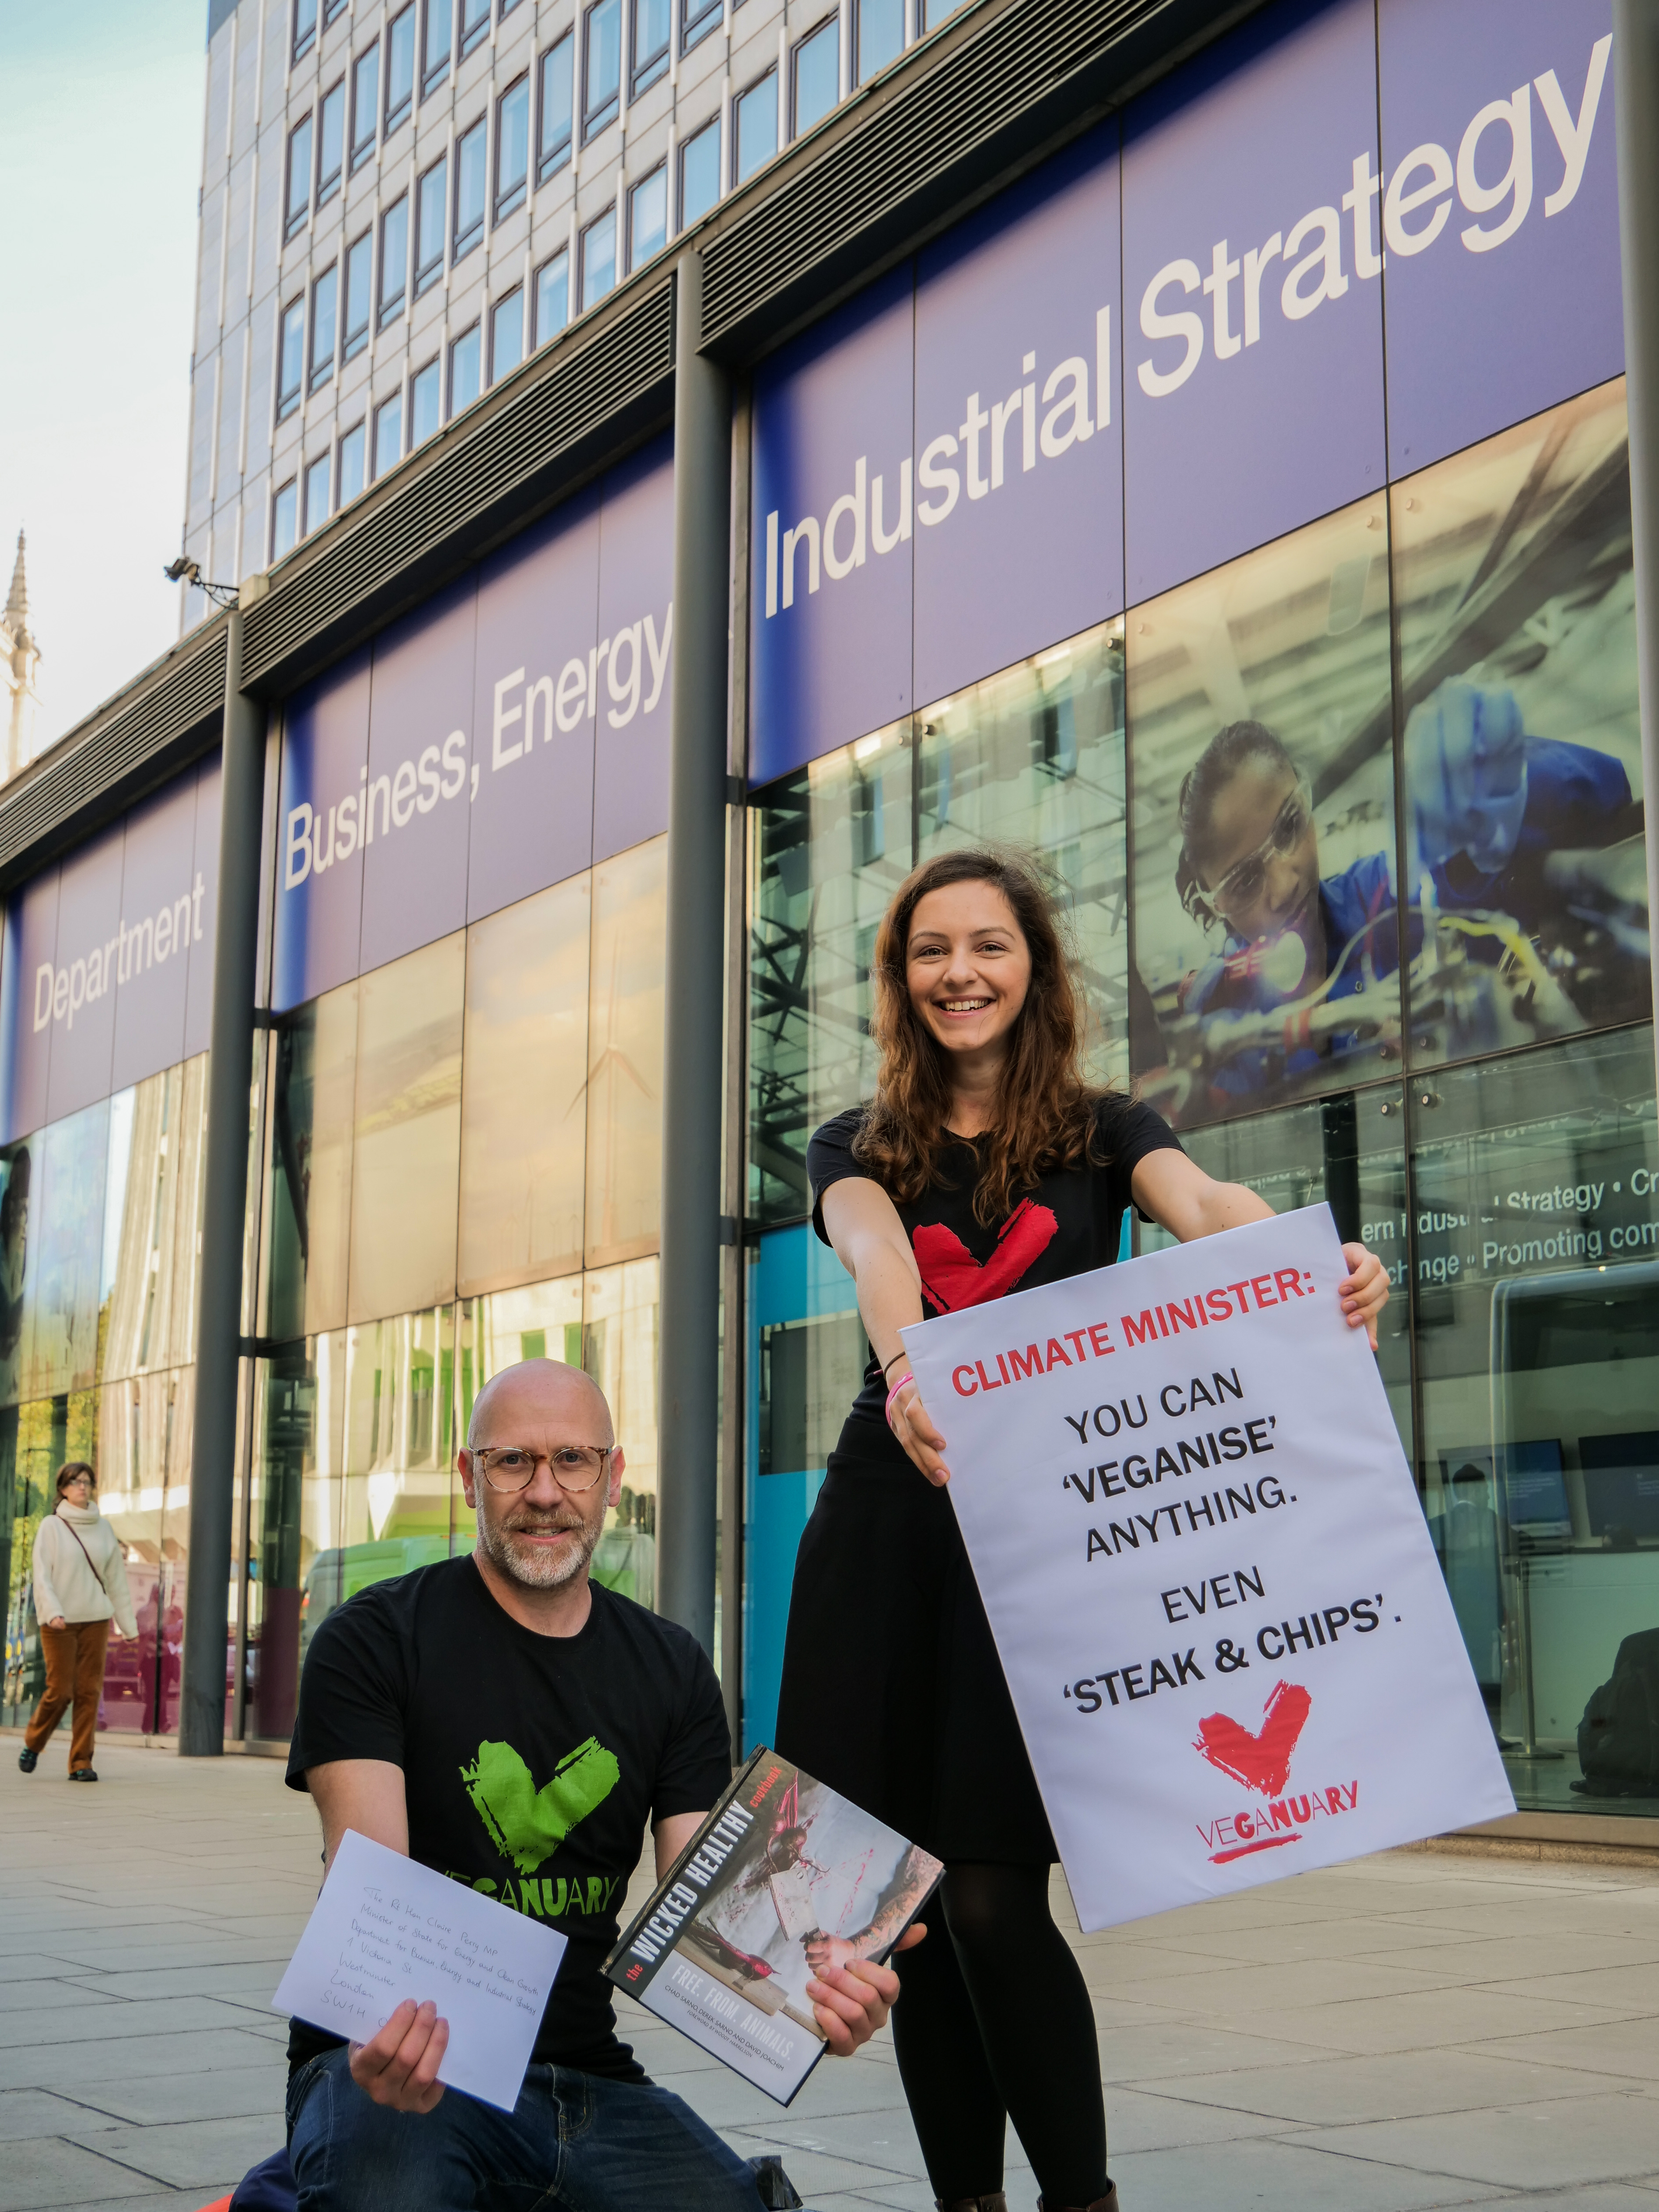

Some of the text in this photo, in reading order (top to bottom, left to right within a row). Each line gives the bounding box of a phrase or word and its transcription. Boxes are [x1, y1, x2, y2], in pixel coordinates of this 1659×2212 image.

[764, 32, 1613, 619] Industrial Strategy
[284, 602, 673, 891] Business, Energy
[33, 871, 205, 1033] Department
[1361, 1220, 1394, 1243] ern
[1507, 1181, 1604, 1212] Strategy
[1387, 1255, 1460, 1283] chnge
[1483, 1228, 1602, 1269] Promoting
[952, 1268, 1316, 1397] CLIMATE MINISTER:
[1063, 1367, 1244, 1445] YOU CAN
[1087, 1476, 1297, 1563] ANYTHING.
[1160, 1565, 1265, 1624] EVEN
[1215, 1638, 1250, 1673] &
[1196, 1780, 1358, 1849] VEGANUARY
[444, 1870, 620, 1916] GANUARY
[627, 1766, 782, 1982] the WICKED HEALTHY cookbook
[347, 1937, 412, 1974] 1 Victoria St
[361, 1904, 394, 1925] Minister
[412, 1929, 432, 1943] State
[437, 1939, 448, 1950] for
[455, 1947, 475, 1968] Energy
[479, 1962, 493, 1972] and
[498, 1969, 514, 1984] Clean
[518, 1979, 538, 1996] Growth
[364, 1887, 498, 1956] The Rt Hon Claire Perry MP
[330, 1969, 374, 1999] London
[340, 1952, 395, 1986] Westminster
[351, 1918, 390, 1945] Department
[395, 1940, 407, 1951] for
[441, 1961, 462, 1983] Energy
[467, 1978, 481, 1988] and
[486, 1983, 512, 2002] Industrial
[516, 1997, 536, 2015] Strategy
[665, 1985, 784, 2071] CHAD SARNO, DEREK SARNO AND DAVID JOACHIM
[672, 1965, 793, 2060] FREE. FROM. ANIMALS.
[687, 2010, 709, 2027] FOREWORD
[714, 2028, 729, 2041] WOODY
[729, 2040, 753, 2058] HARRELSON
